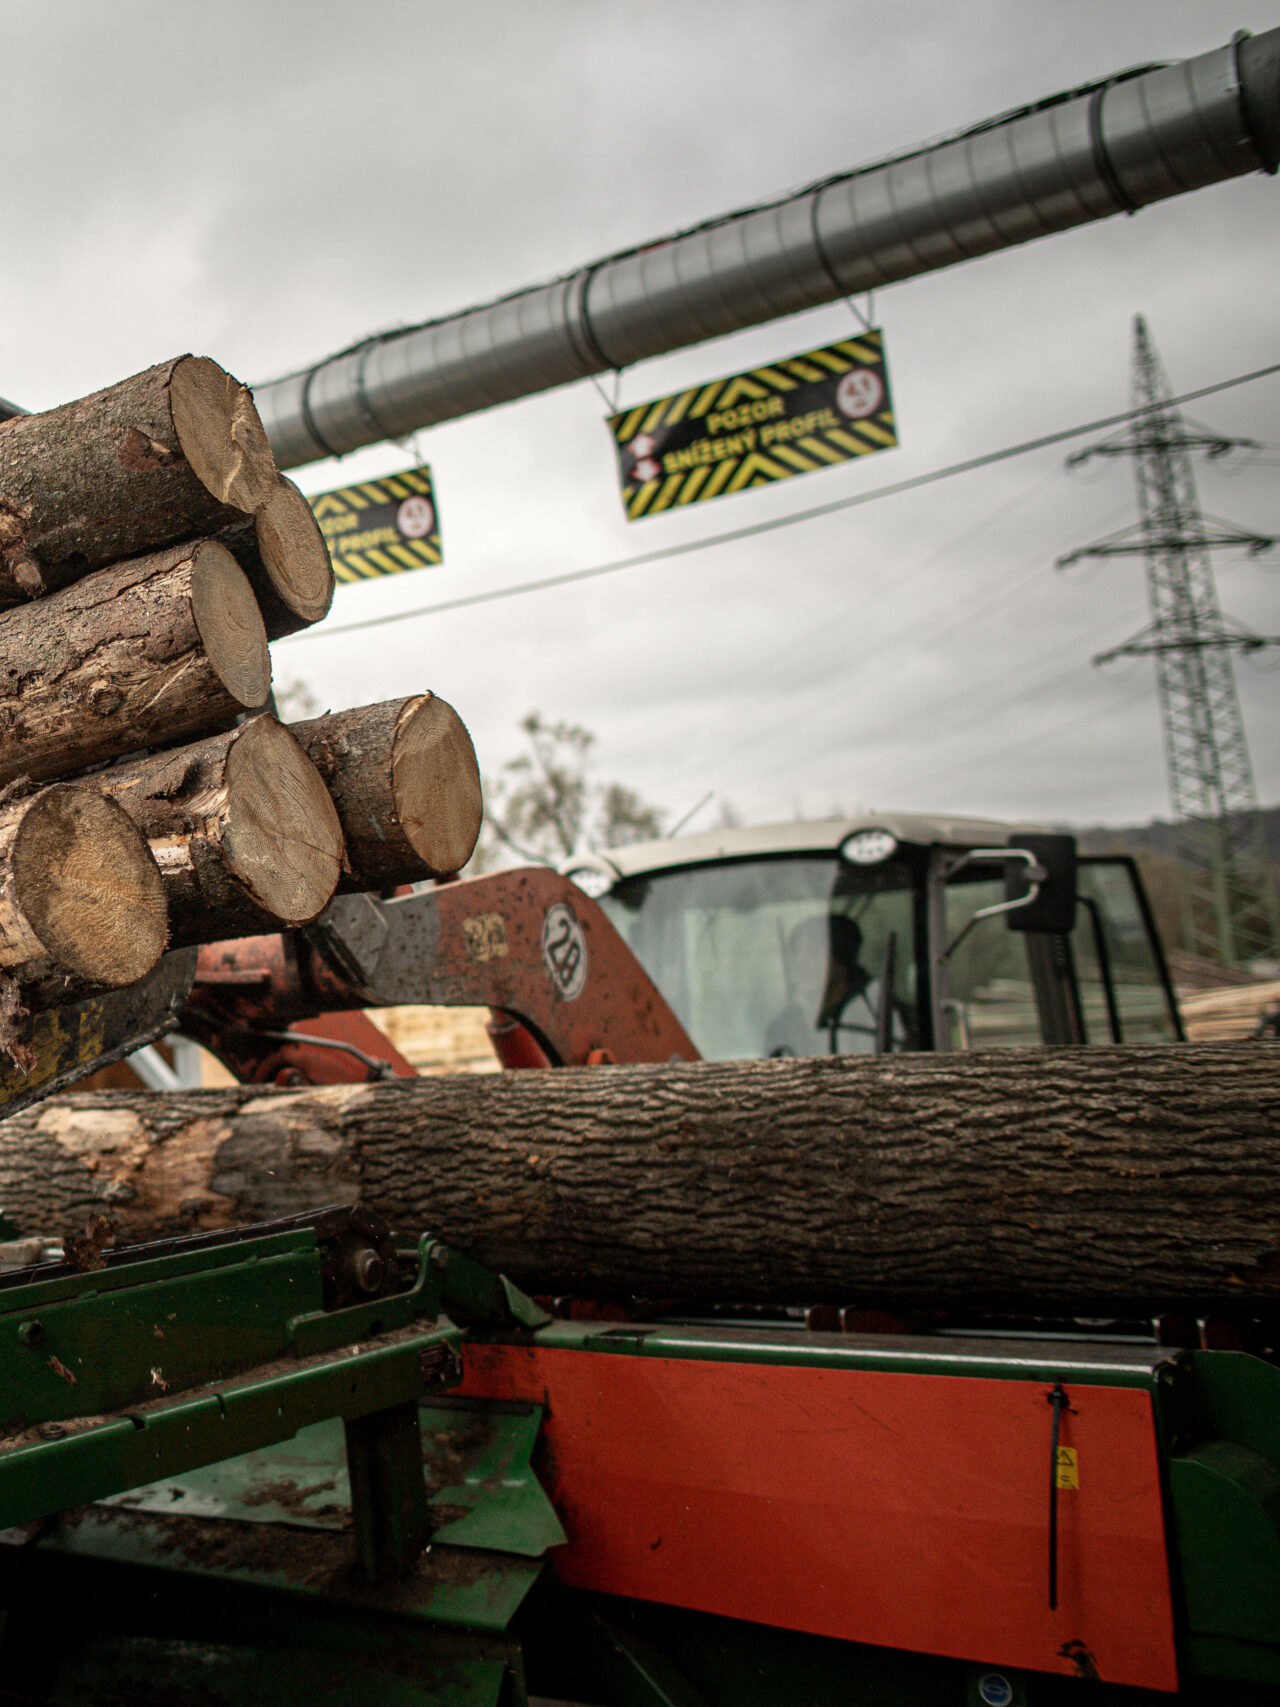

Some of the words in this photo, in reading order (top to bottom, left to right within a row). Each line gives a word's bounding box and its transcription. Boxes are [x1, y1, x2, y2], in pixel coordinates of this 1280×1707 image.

[662, 429, 757, 474] SNÍŽENÝ
[760, 407, 841, 446] PROFIL
[707, 397, 784, 433] POZOR
